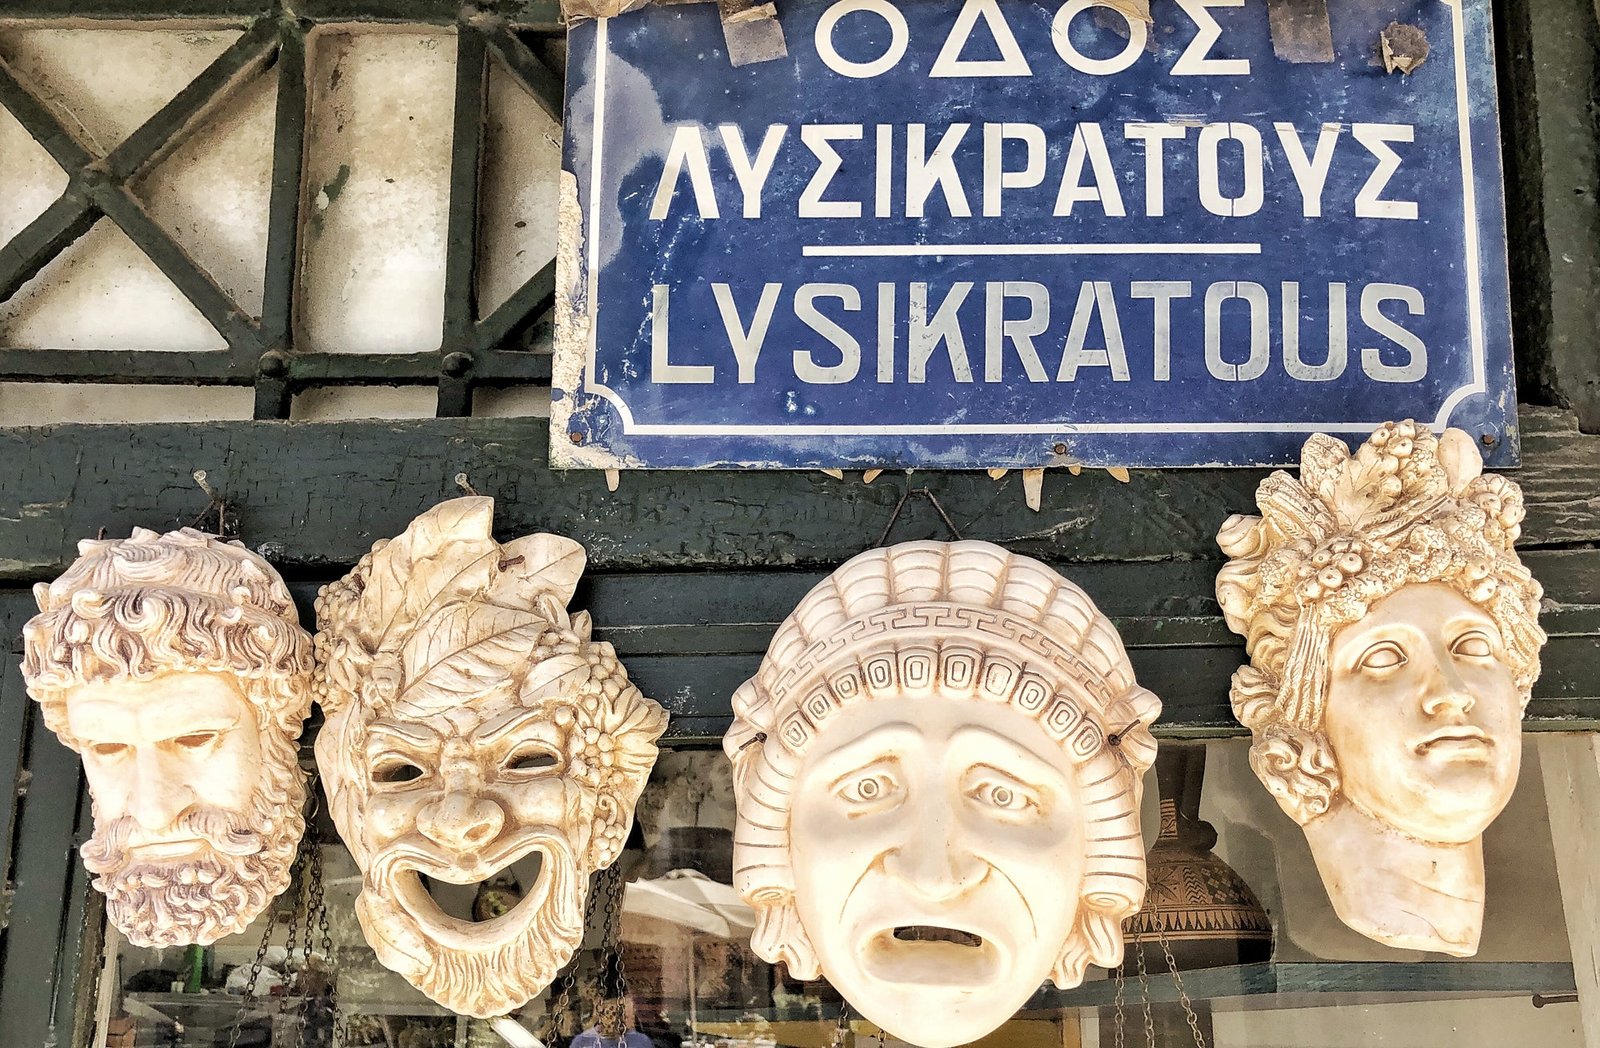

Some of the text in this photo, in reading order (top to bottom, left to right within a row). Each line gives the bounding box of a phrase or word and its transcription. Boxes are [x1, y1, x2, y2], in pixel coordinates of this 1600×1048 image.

[814, 0, 1251, 78] ΟΔΟΣ
[648, 122, 1419, 220] ΛΥΣΙΚΡΑΤΟΥΣ
[651, 281, 1428, 384] LYSIKRATOUS
